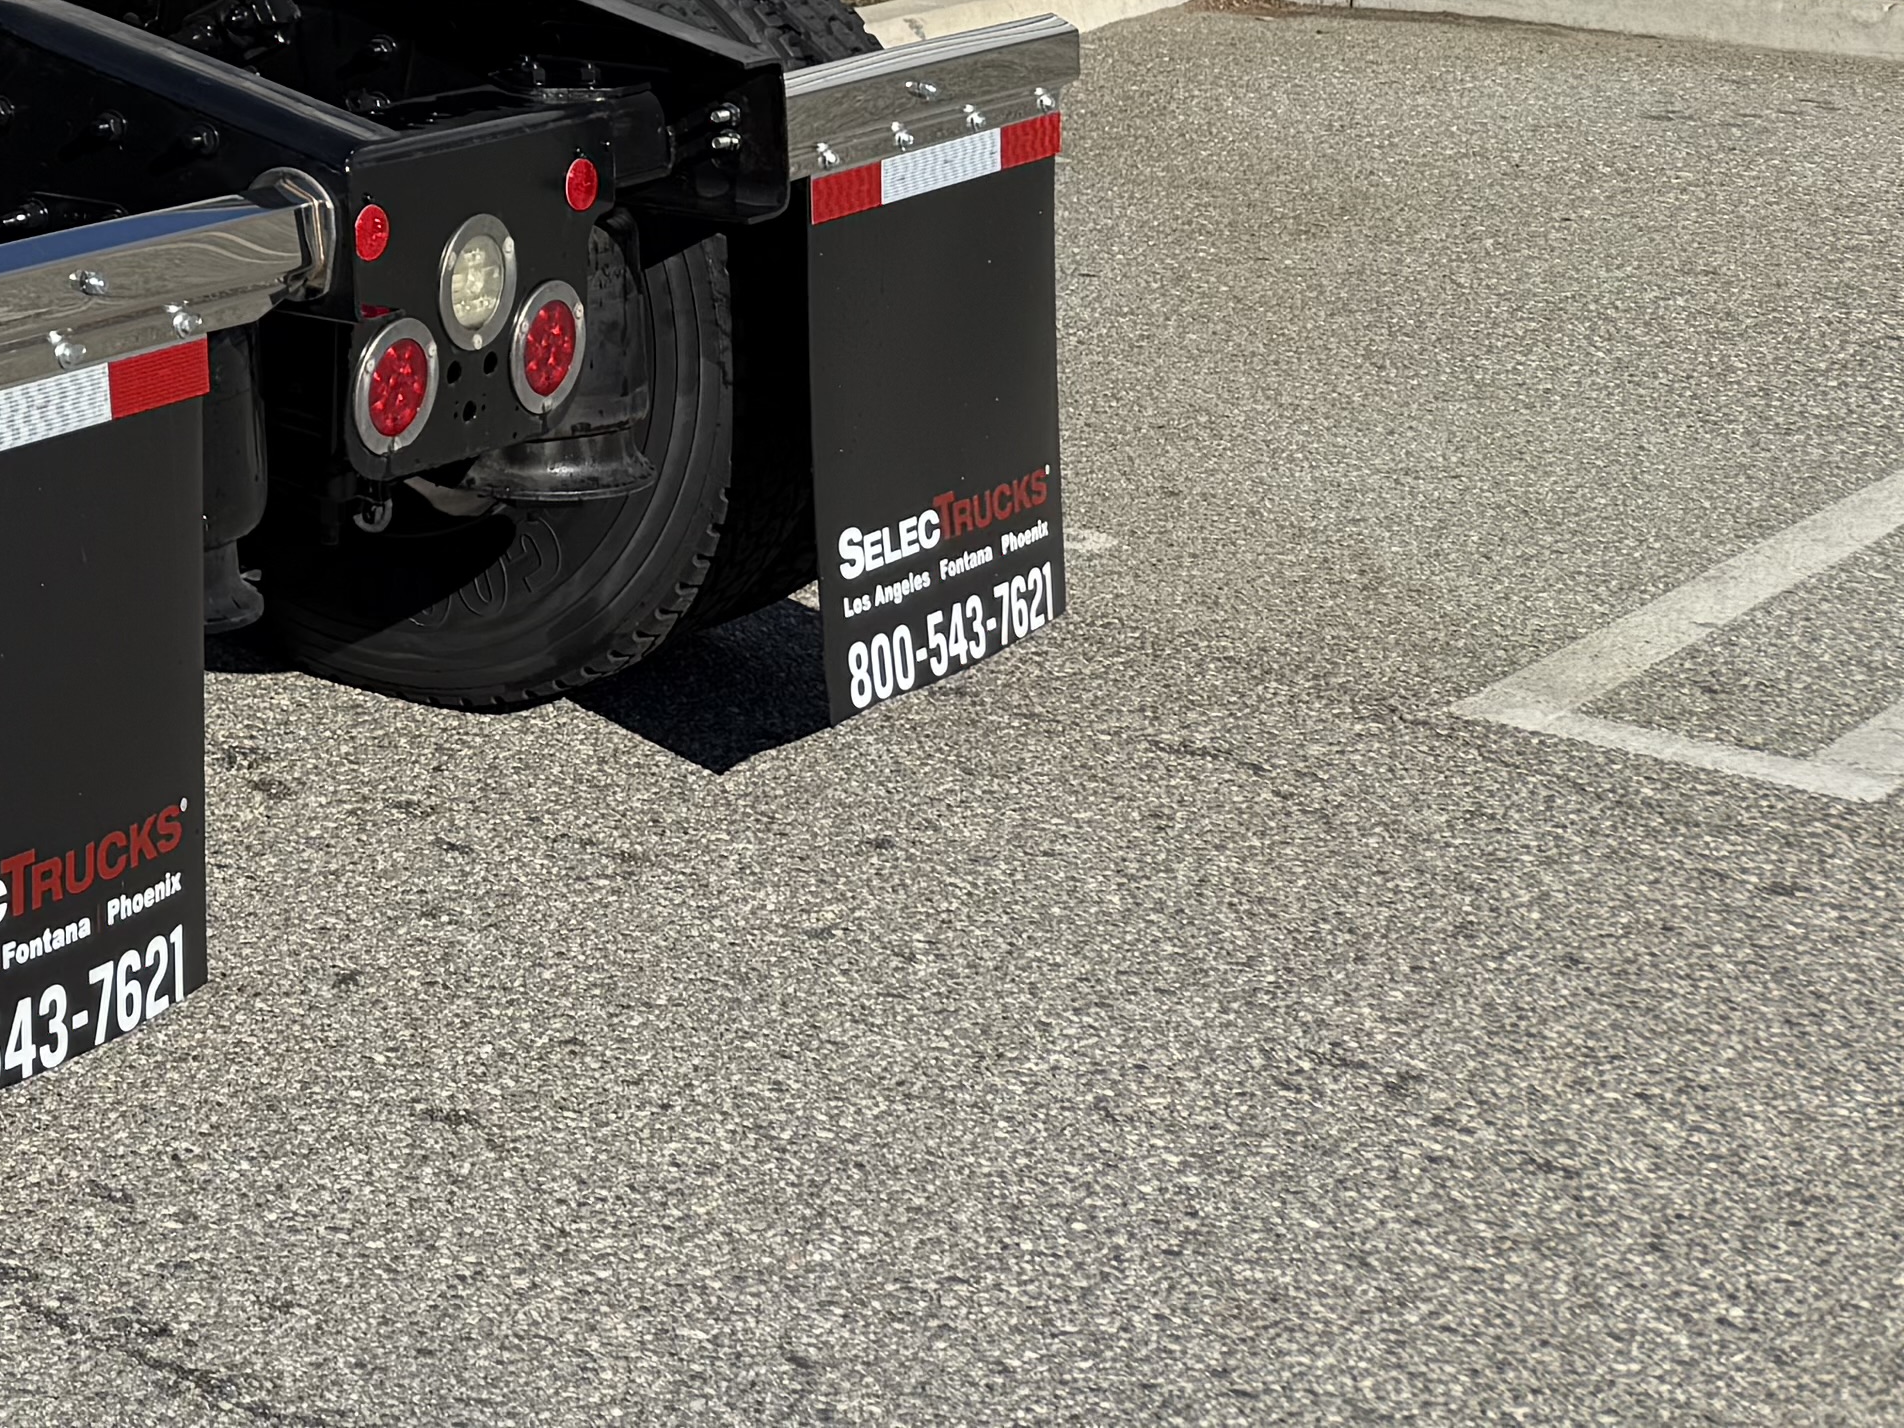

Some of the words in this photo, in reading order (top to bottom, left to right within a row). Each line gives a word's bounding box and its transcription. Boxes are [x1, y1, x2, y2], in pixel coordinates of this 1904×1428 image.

[843, 597, 871, 618] Los
[875, 570, 931, 606] Angeles
[939, 545, 993, 580] Fontana
[1001, 519, 1049, 555] Phoenix
[848, 561, 1053, 709] 800-543-7621
[2, 915, 91, 970] Fontana
[107, 869, 182, 925] Phoenix
